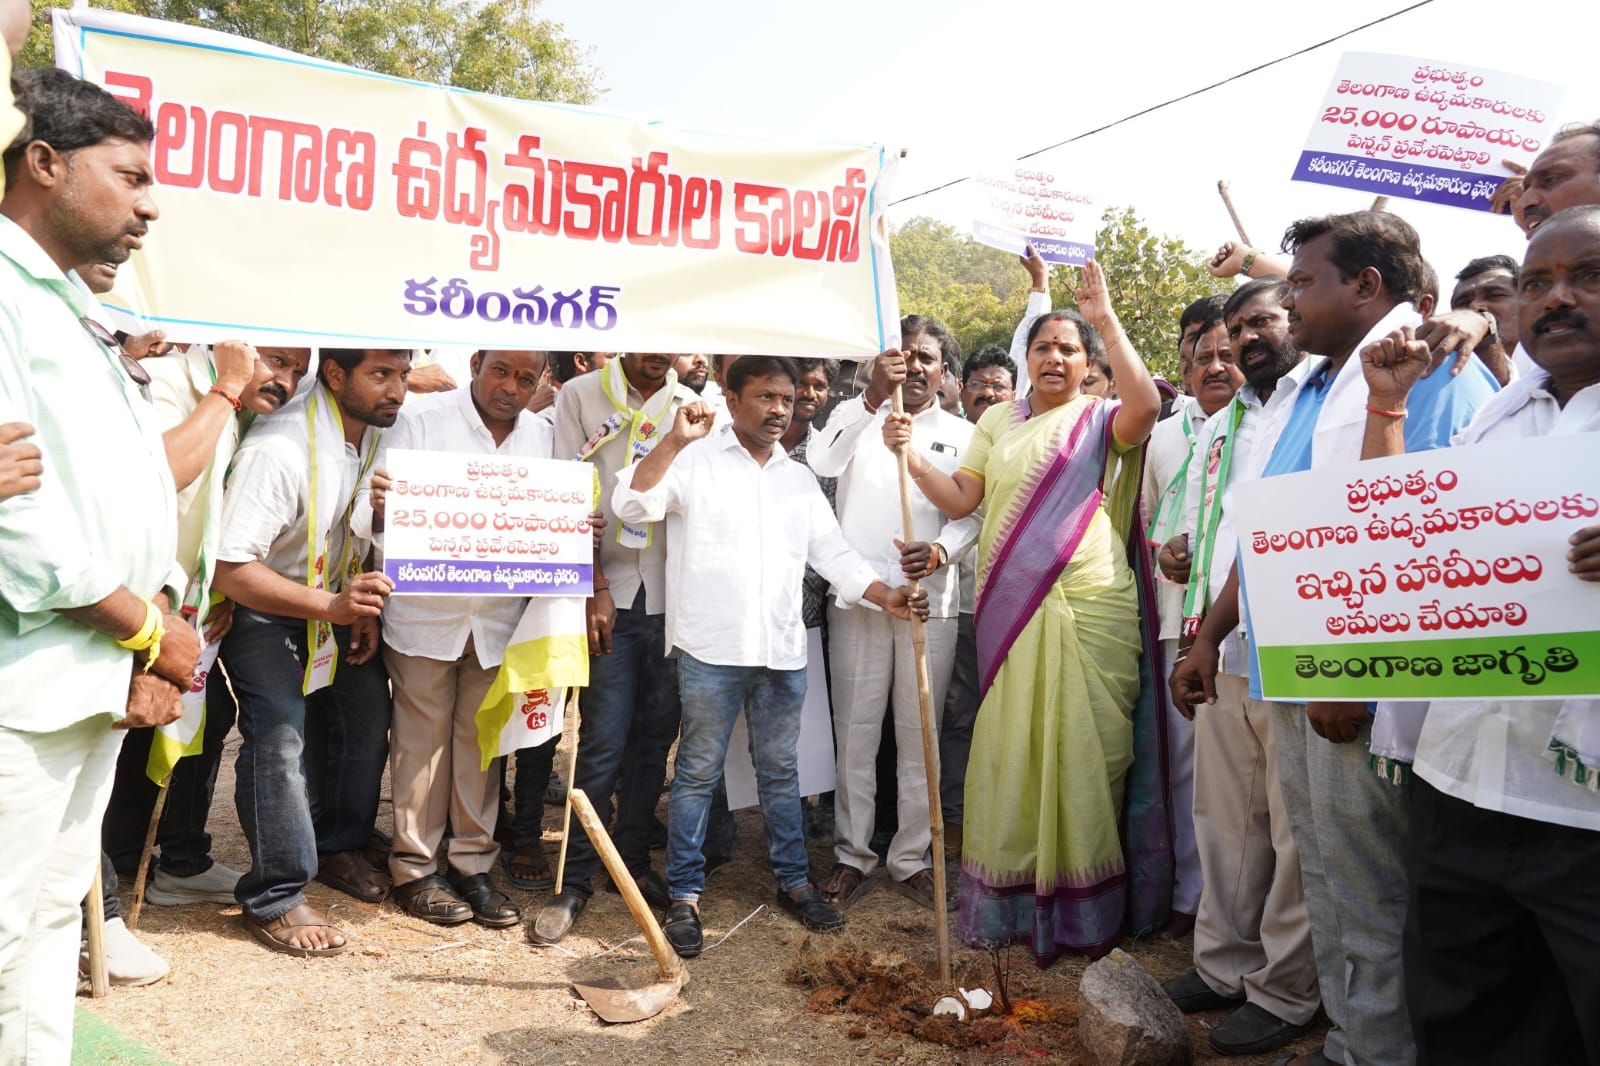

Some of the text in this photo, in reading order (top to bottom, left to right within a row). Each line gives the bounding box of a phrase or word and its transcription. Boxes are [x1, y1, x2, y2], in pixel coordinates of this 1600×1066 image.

[1412, 66, 1483, 89] ప్రభుత్వం
[1336, 80, 1545, 123] తెలంగాణ ఉద్యమకారులకు
[1421, 115, 1541, 152] రూపాయల
[1391, 139, 1491, 169] ప్రవేశపెట్టాలి
[1307, 156, 1355, 177] కరీంనగర్
[1354, 162, 1401, 184] తెలంగాణ
[1403, 168, 1472, 195] ఉద్యమకారుల
[391, 121, 723, 271] ఉద్యమకారుల
[734, 167, 867, 263] కాలనీ
[403, 276, 620, 331] కరీంనగర్
[467, 461, 528, 483] ప్రభుత్వం
[1346, 469, 1458, 513] ప్రభుత్వం
[395, 480, 586, 507] తెలంగాణ ఉద్యమకారులకు
[493, 512, 592, 534] రూపాయల
[1252, 493, 1599, 555] తెలంగాణ ఉద్యమకారులకు
[398, 562, 446, 582] కరీంనగర్
[448, 566, 491, 583] తెలంగాణ
[493, 566, 552, 590] ఉద్యమకారుల
[1296, 549, 1543, 608] ఇచ్చిన హామీలు
[1326, 599, 1527, 636] అమలు చేయాలి
[1295, 645, 1579, 685] తెలంగాణ జాగృతి
